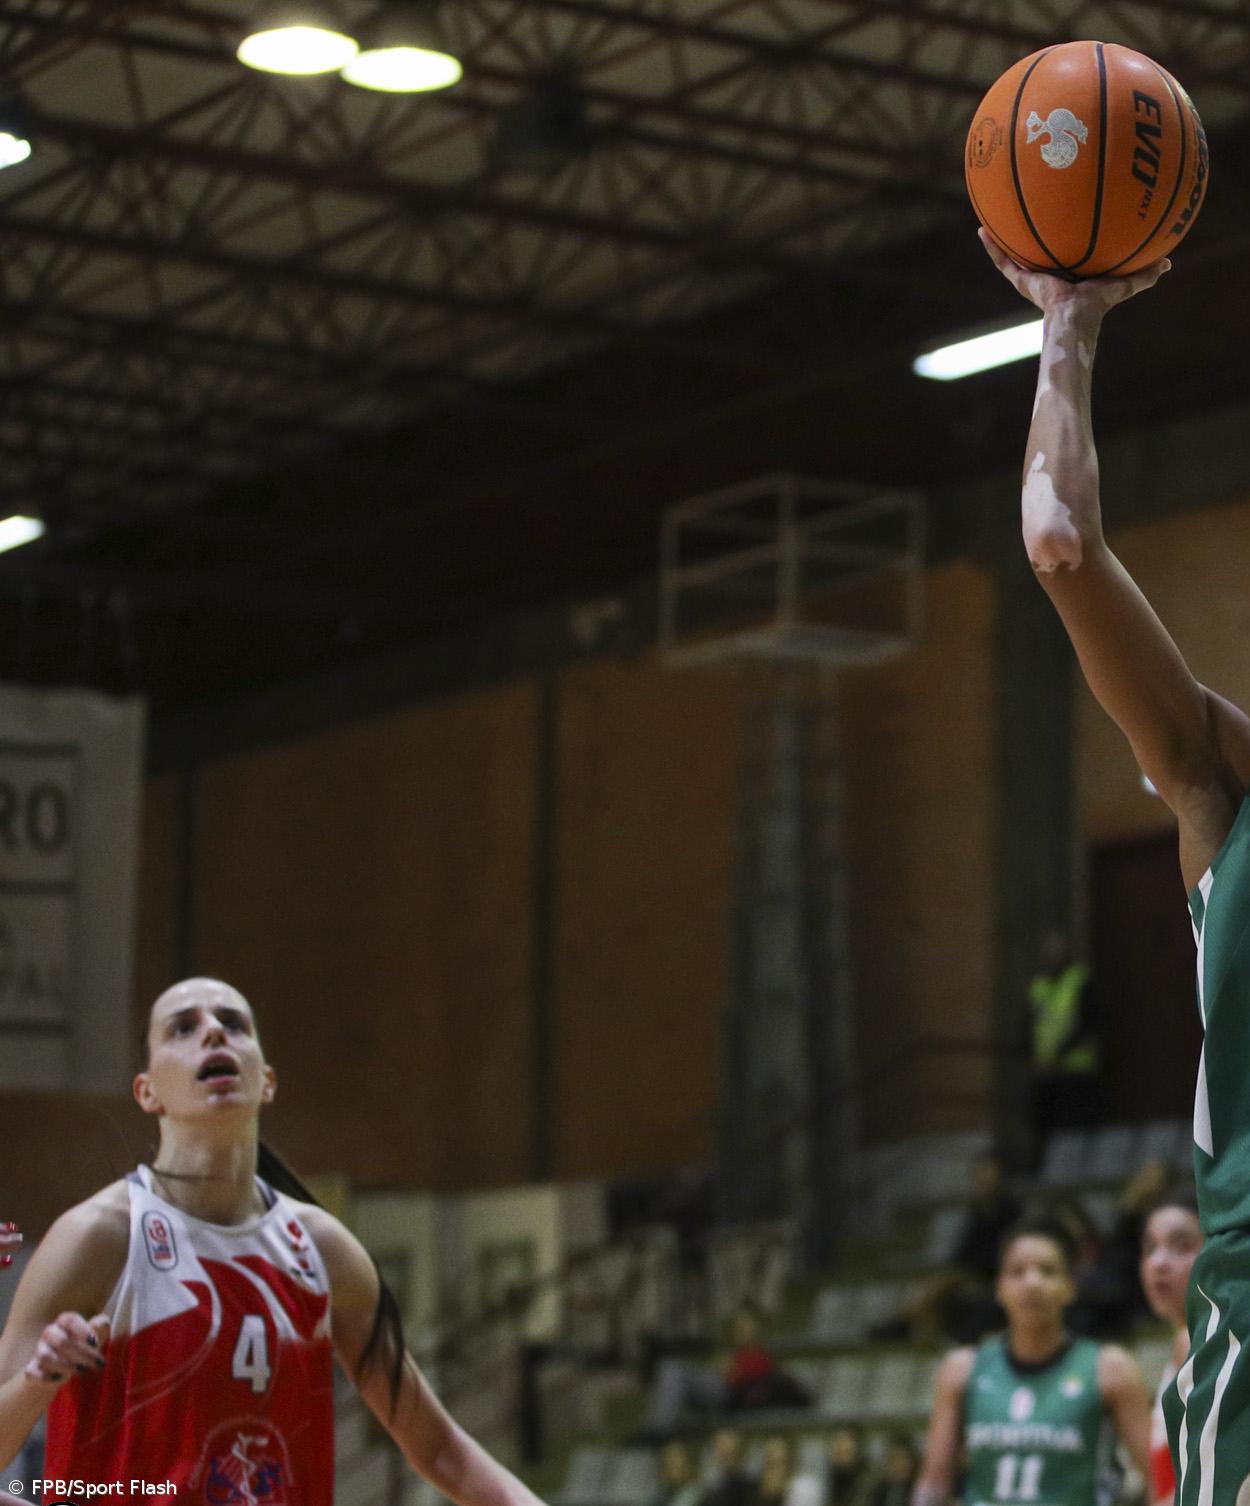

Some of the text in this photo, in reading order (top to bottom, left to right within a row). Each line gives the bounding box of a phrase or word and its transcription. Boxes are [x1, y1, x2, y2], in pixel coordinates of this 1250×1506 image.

[1132, 89, 1162, 189] EVO
[232, 1315, 273, 1393] 4
[996, 1454, 1042, 1500] 11
